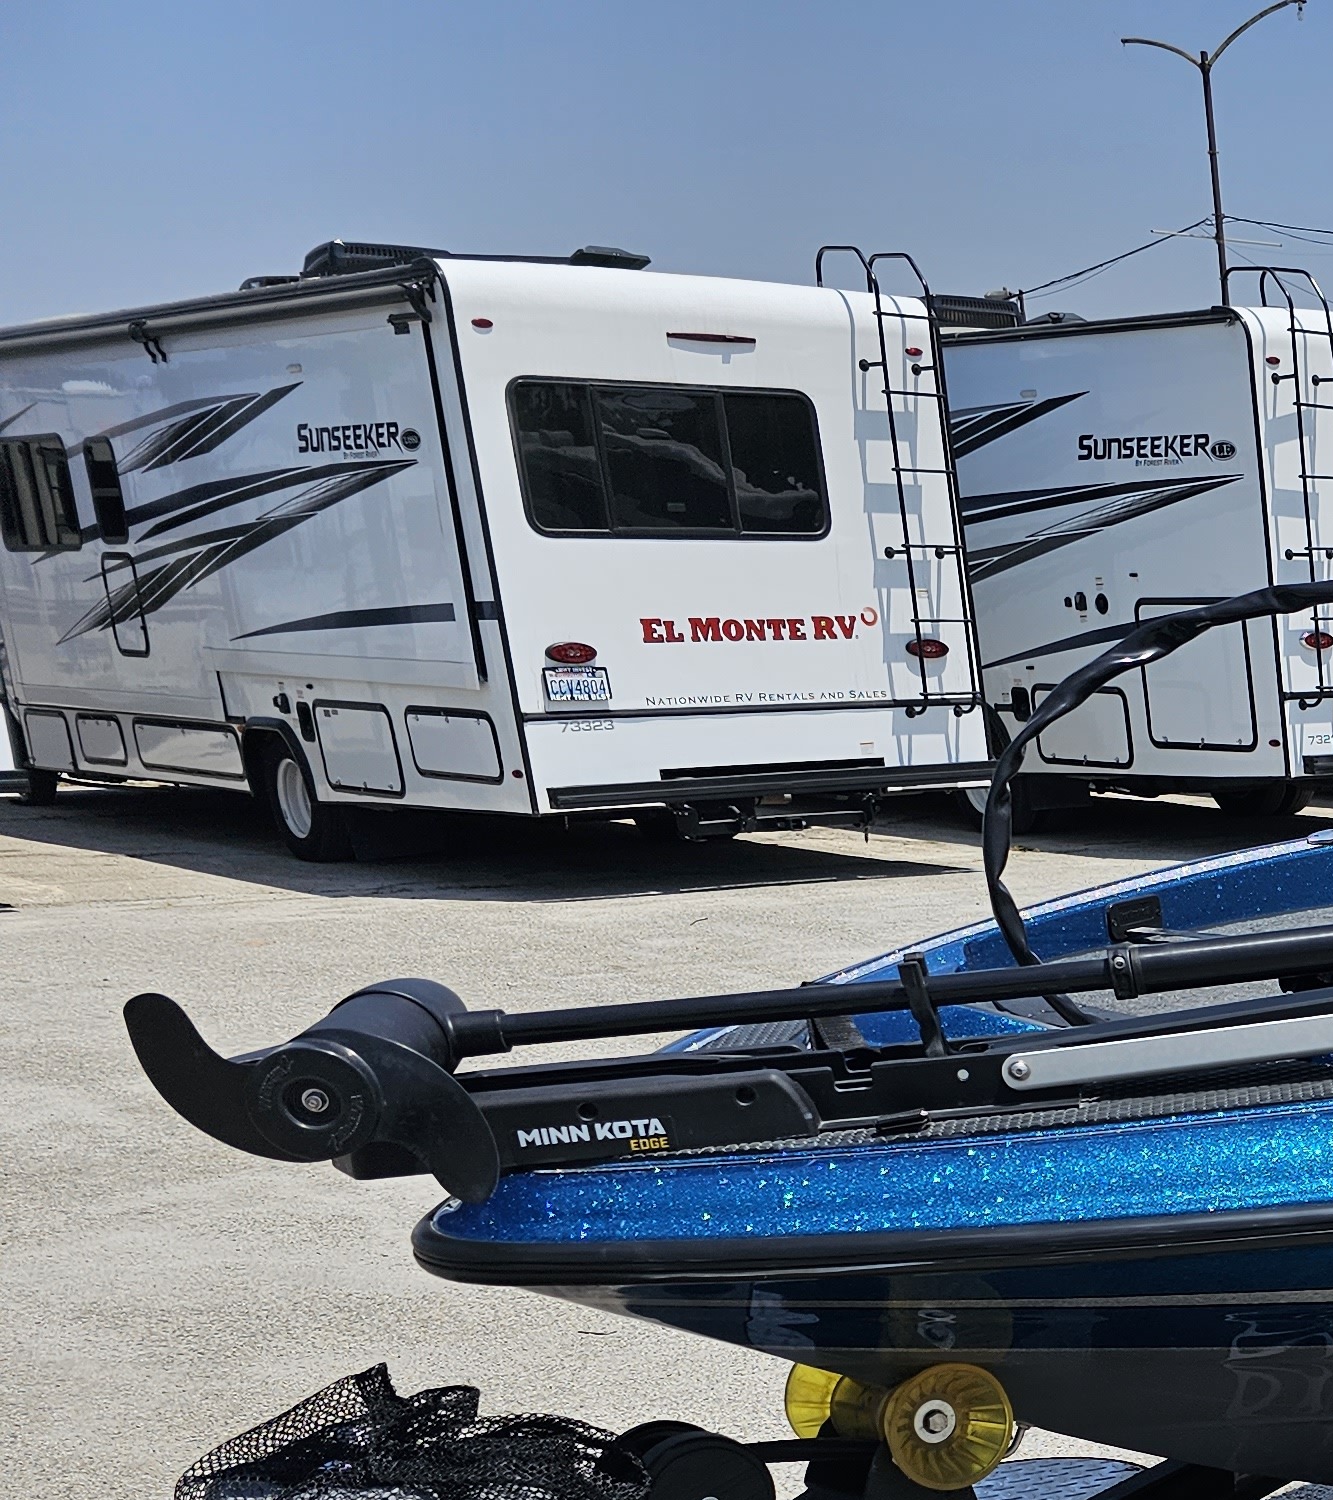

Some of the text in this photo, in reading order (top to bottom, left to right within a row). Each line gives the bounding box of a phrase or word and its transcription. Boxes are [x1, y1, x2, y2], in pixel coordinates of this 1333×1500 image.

[297, 422, 404, 453] SUNSEEKER
[1077, 433, 1233, 462] SUNSEEKER LE
[640, 615, 857, 644] EL MONTE RV
[549, 679, 606, 695] CCV4804
[645, 689, 888, 706] NATIONWIDE RV RENTALS AND SALES
[558, 719, 615, 733] 73323
[516, 1117, 667, 1149] MINN KOTA
[629, 1136, 670, 1151] EDGE
